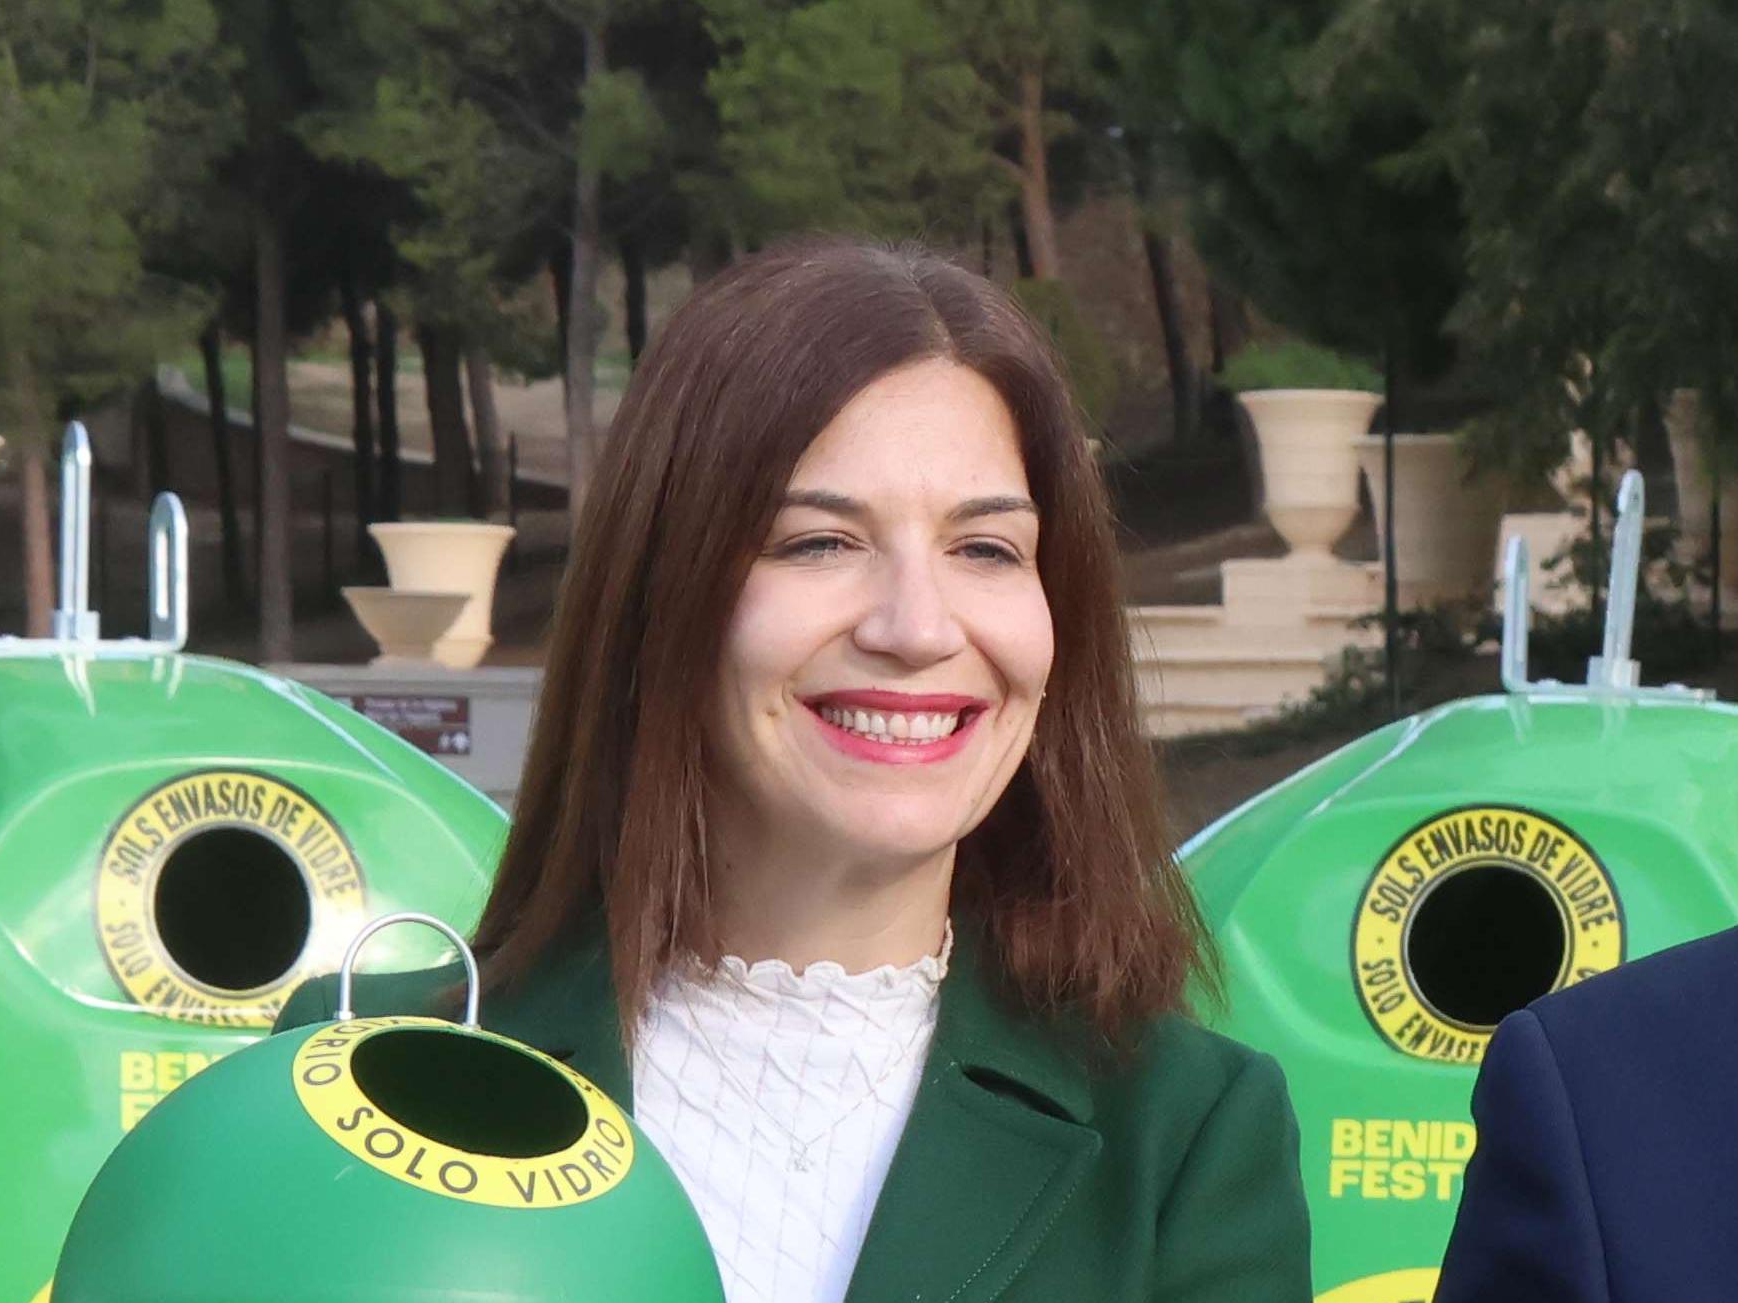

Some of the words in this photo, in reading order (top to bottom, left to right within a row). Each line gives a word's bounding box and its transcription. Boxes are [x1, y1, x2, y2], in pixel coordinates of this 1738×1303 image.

[108, 814, 164, 886] SOLS
[151, 779, 267, 831] ENVASOS
[266, 793, 305, 837] DE
[295, 819, 359, 900] VIDRE
[1369, 854, 1427, 924] SOLS
[1414, 815, 1529, 869] ENVASOS
[1527, 828, 1566, 867] DE
[1554, 851, 1618, 933] VIDRE
[1362, 957, 1407, 1015] SOLO
[336, 1106, 478, 1194] SOLO
[506, 1118, 626, 1203] VIDRIO
[1330, 1118, 1478, 1162] BENID
[1329, 1158, 1464, 1201] FEST
